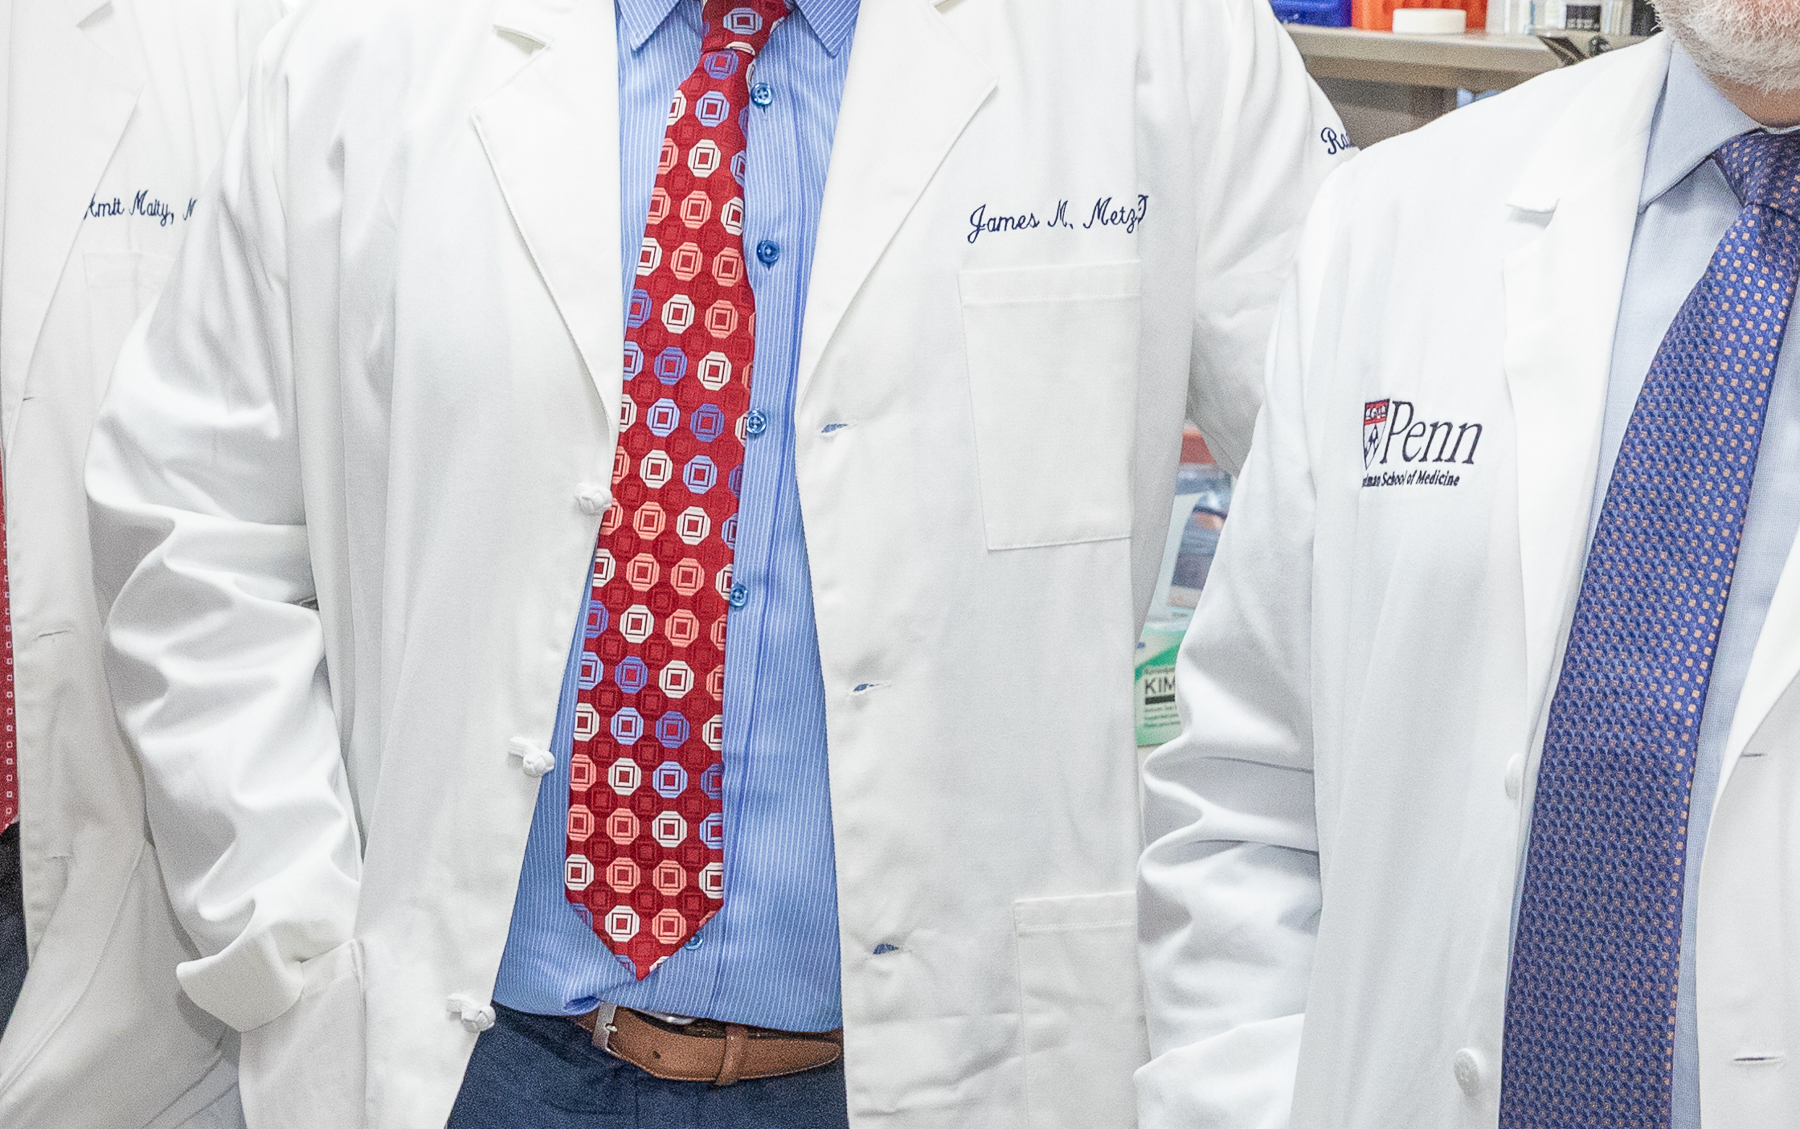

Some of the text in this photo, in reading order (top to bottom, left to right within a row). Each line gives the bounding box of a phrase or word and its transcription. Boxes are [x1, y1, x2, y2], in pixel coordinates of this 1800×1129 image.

[967, 203, 1040, 244] James
[1379, 400, 1483, 465] Penn
[1381, 470, 1407, 487] School
[1407, 469, 1418, 485] of
[1415, 469, 1460, 487] Medicine
